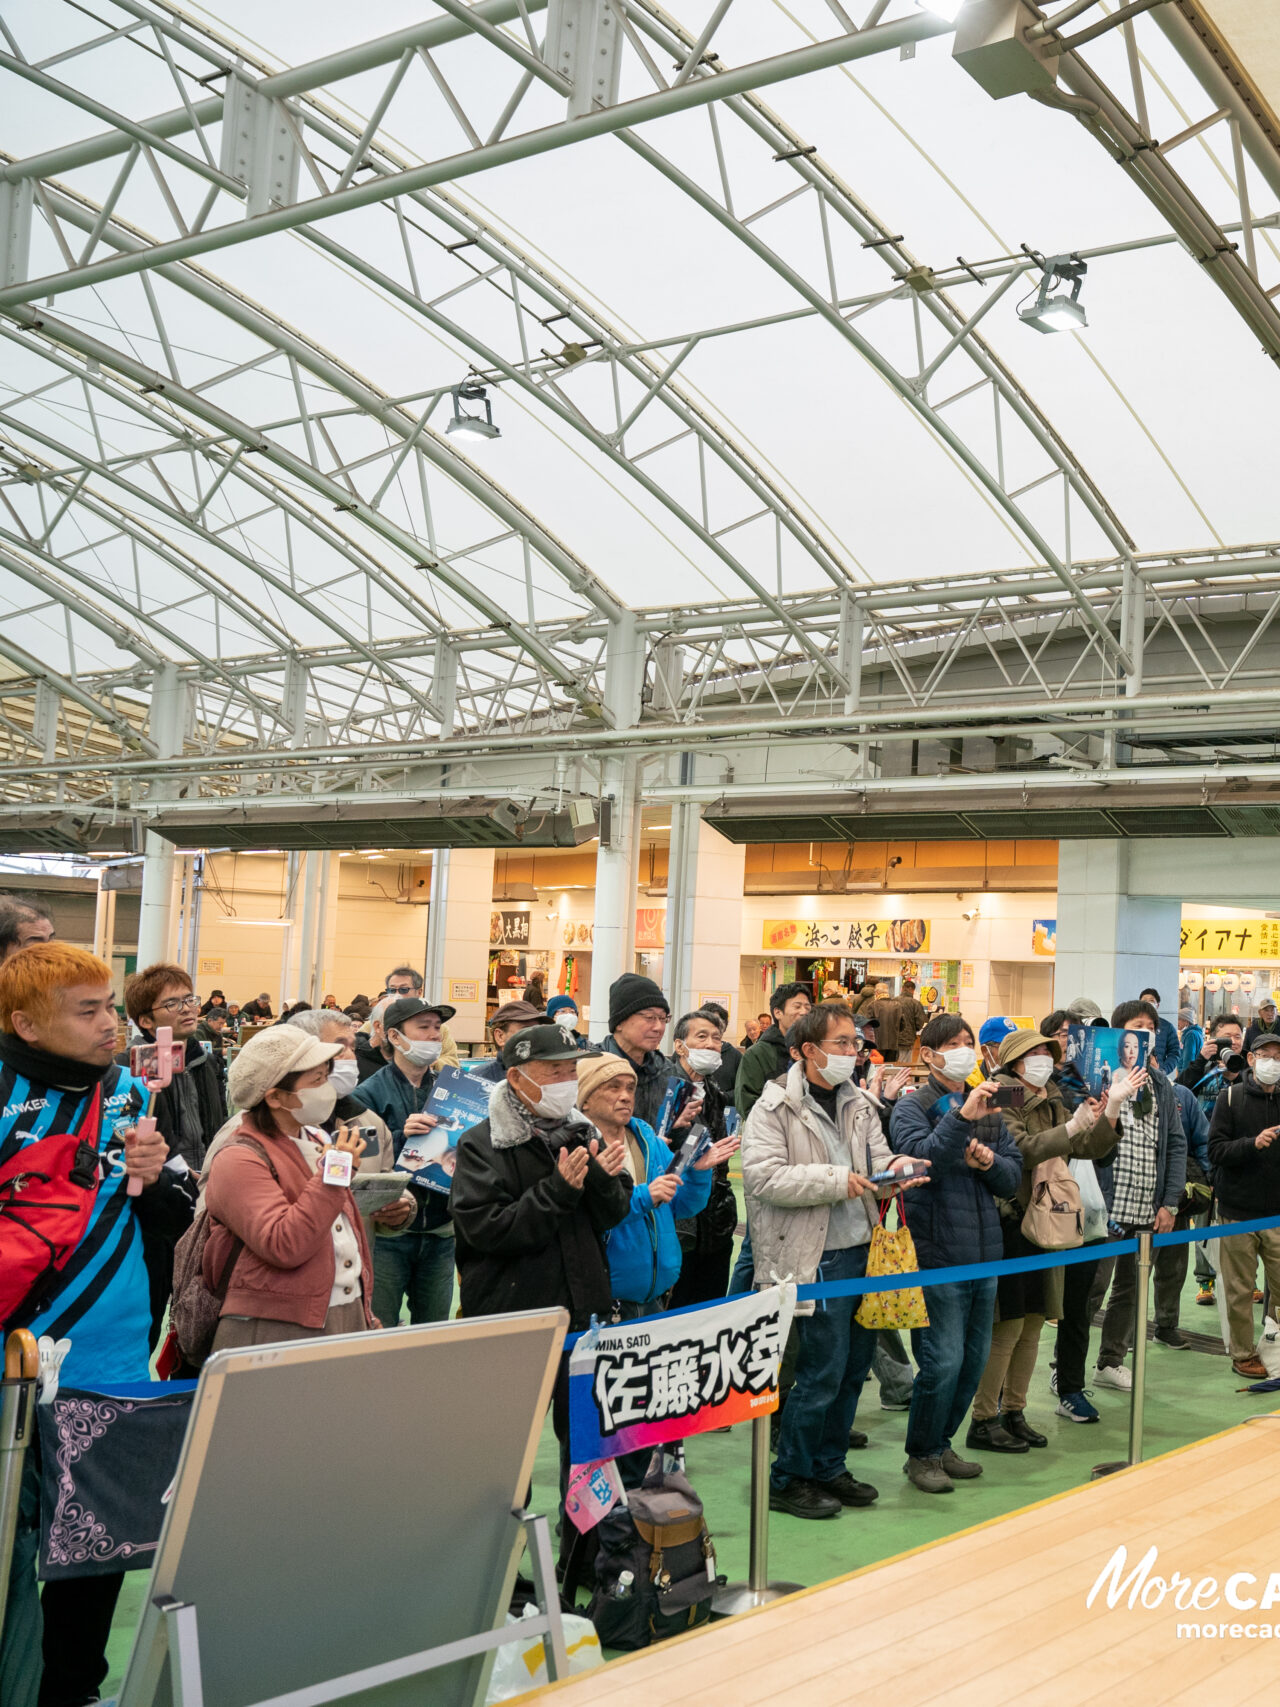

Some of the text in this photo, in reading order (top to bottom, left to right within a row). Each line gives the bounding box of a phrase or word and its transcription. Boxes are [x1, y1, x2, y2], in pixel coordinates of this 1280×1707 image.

[3, 1098, 50, 1118] ANKER
[596, 1334, 651, 1352] MINA SATO
